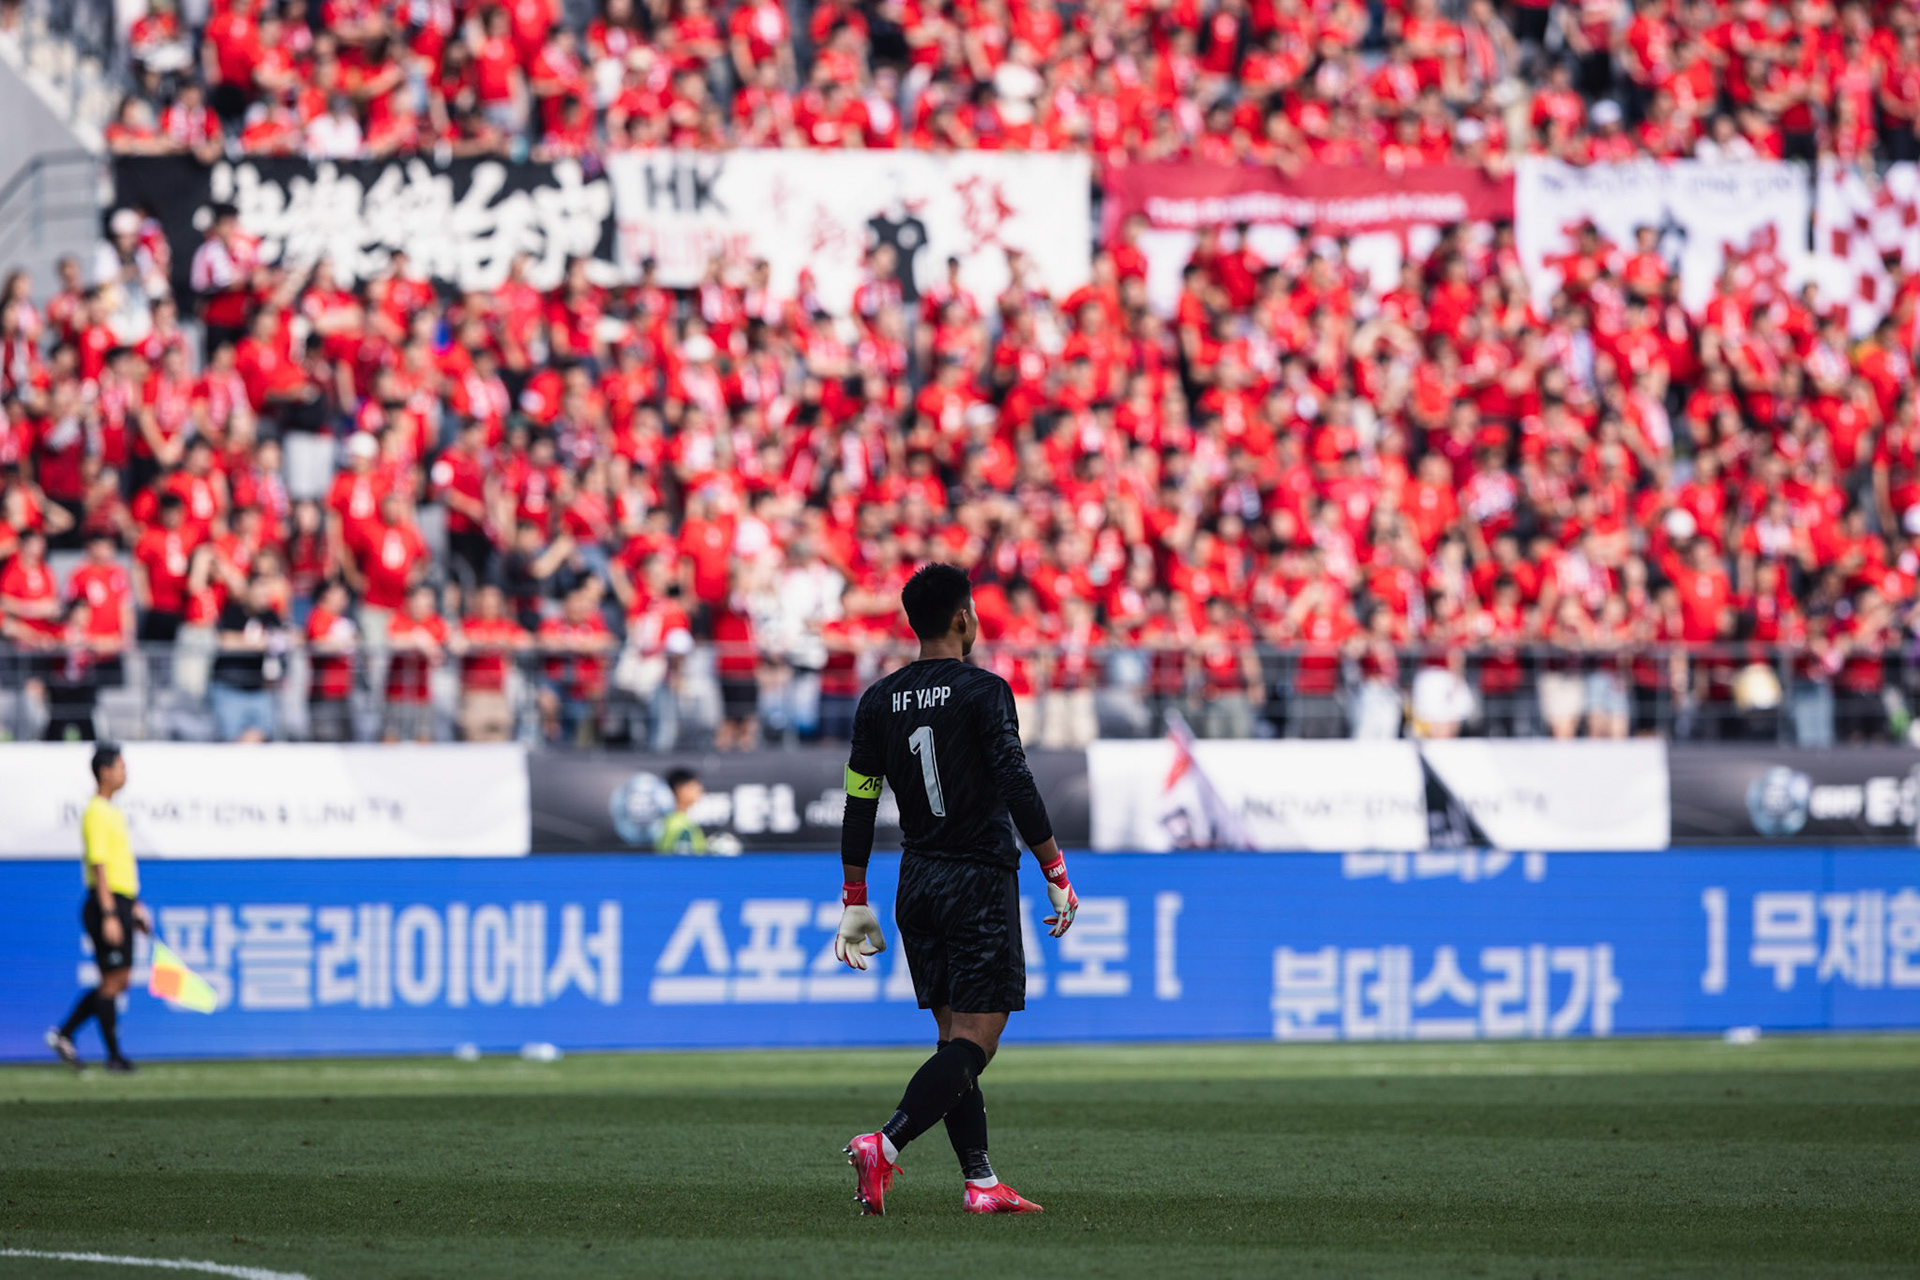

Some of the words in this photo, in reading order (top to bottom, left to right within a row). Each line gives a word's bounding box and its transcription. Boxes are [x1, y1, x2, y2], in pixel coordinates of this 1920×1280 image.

[892, 691, 912, 713] HF
[916, 686, 951, 709] YAPP
[857, 777, 883, 791] AF
[908, 726, 945, 817] 1
[1271, 944, 1622, 1041] 분데스리가
